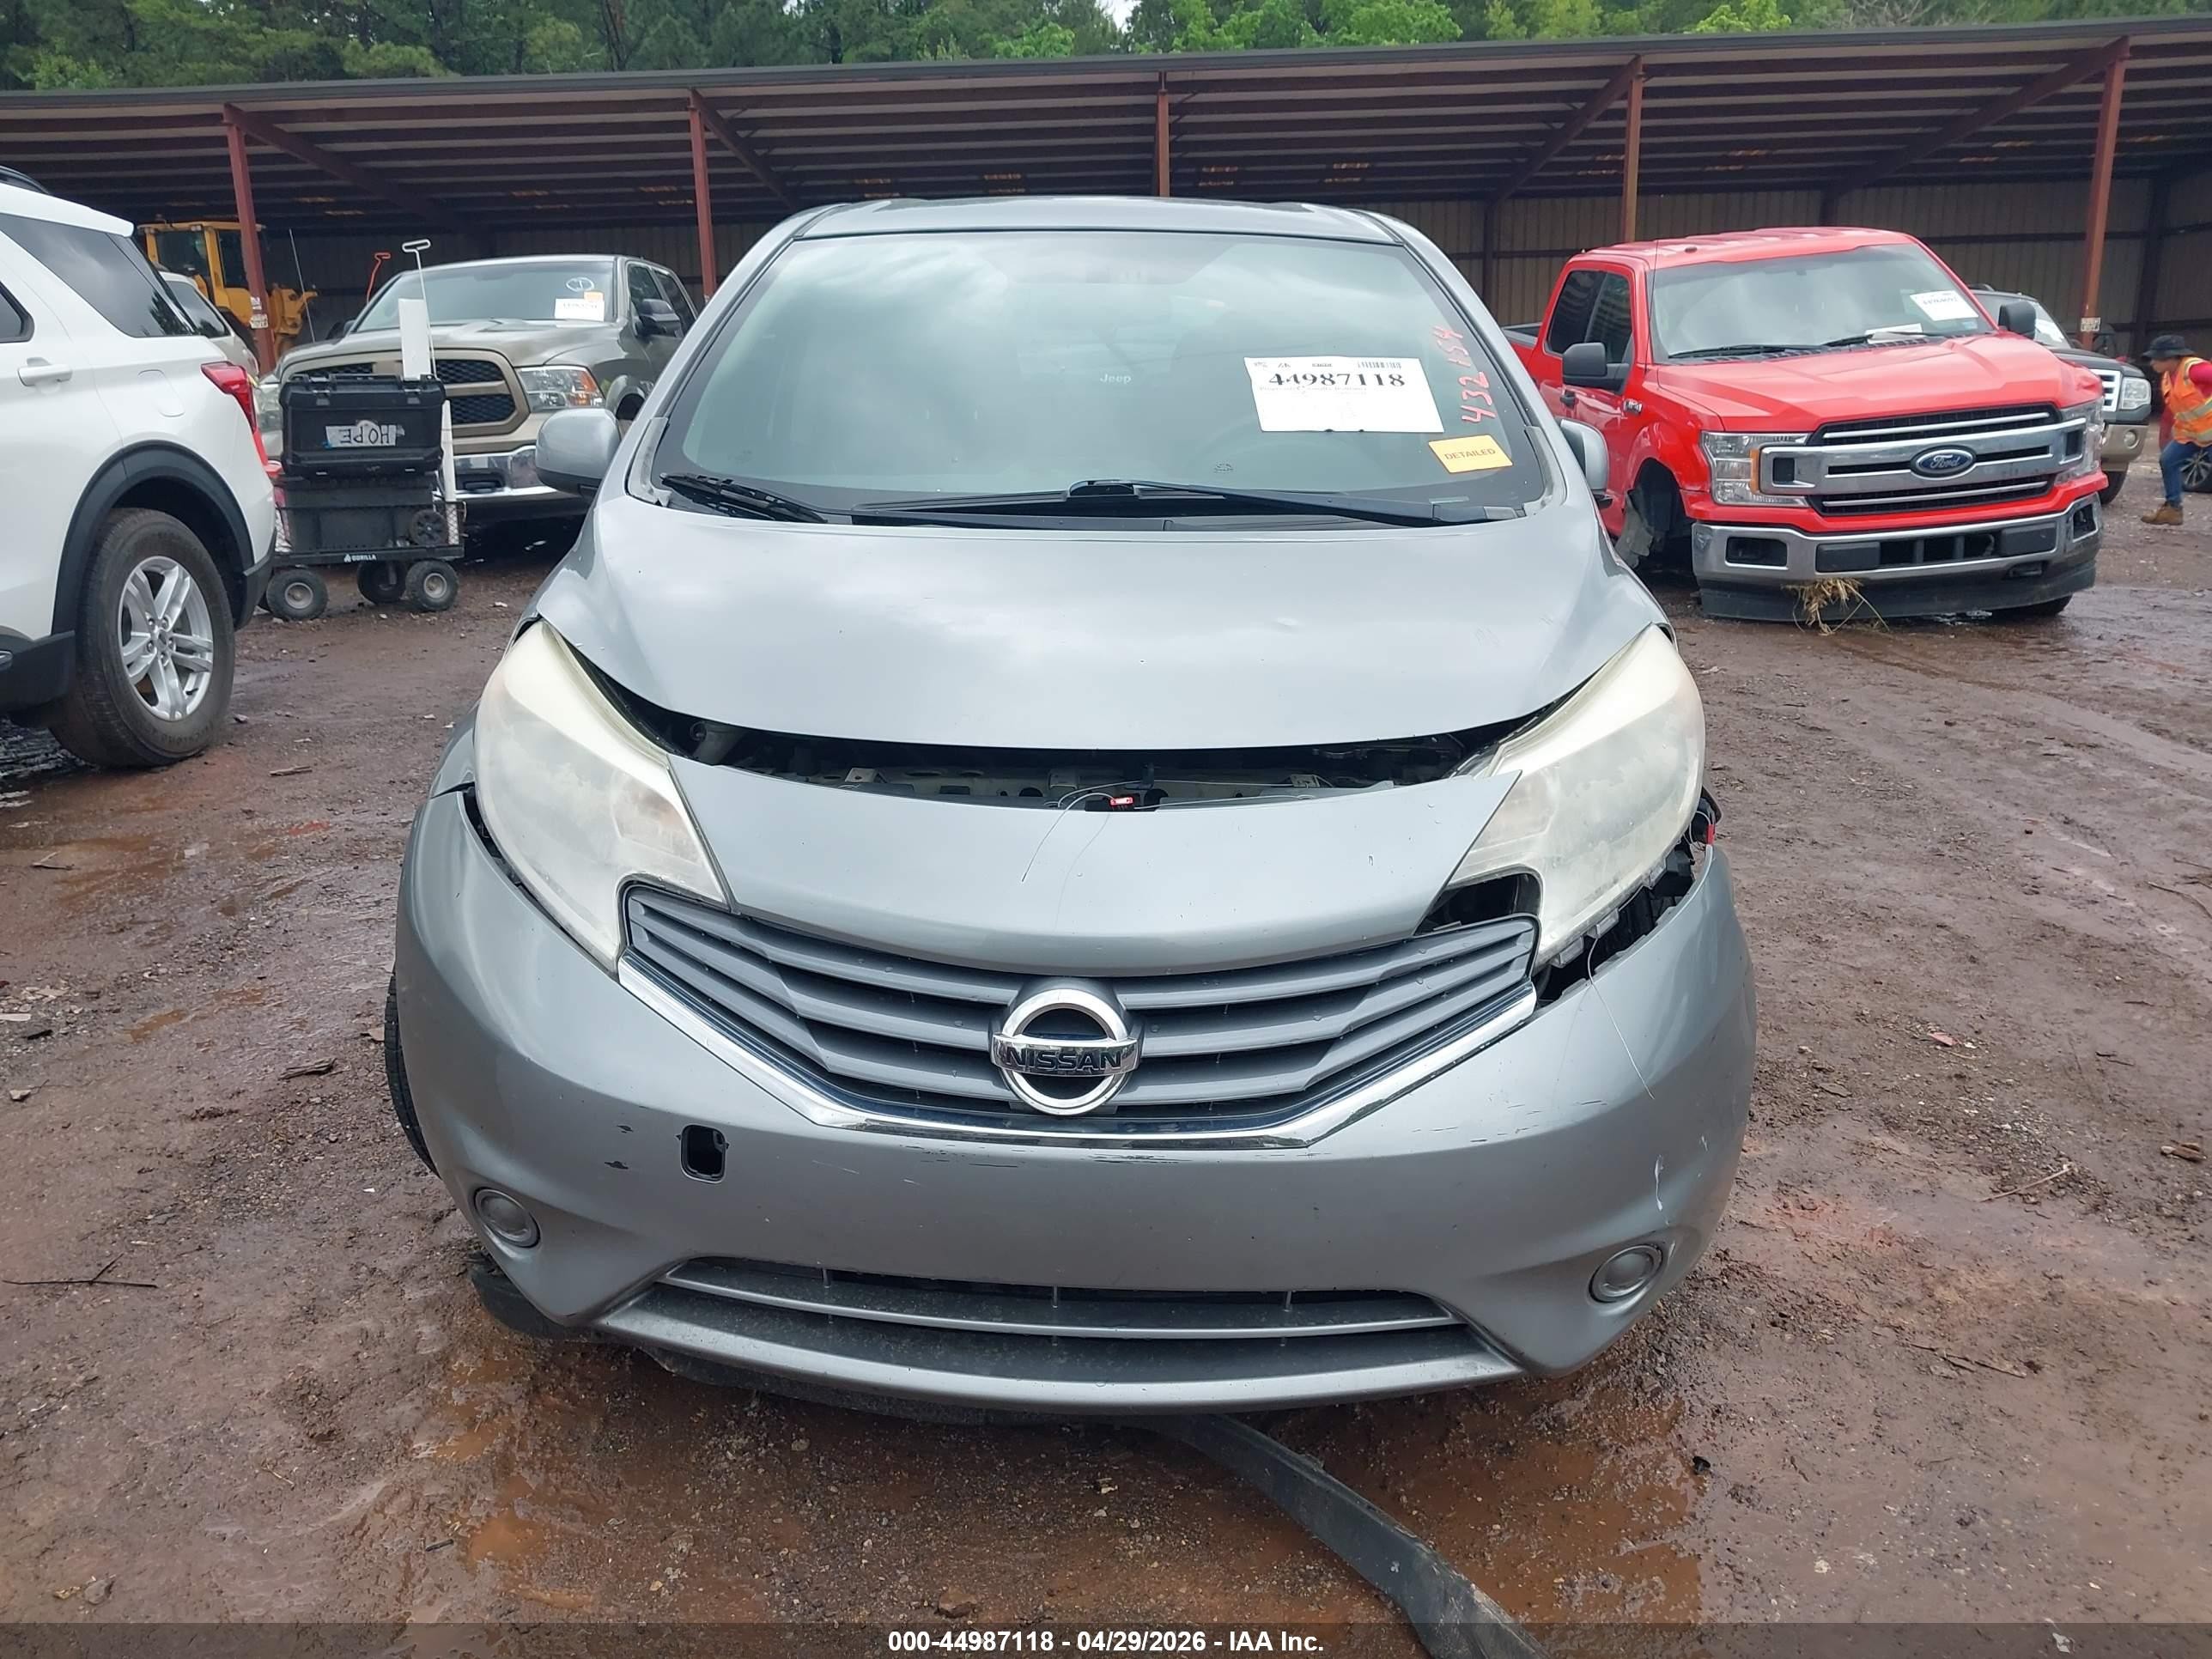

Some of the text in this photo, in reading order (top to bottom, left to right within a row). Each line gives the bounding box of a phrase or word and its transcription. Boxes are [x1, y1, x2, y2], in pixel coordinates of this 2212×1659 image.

[1268, 372, 1407, 387] 44987118
[338, 426, 390, 445] HOPE
[1443, 447, 1497, 461] DETAILED
[1929, 453, 1960, 469] Ford
[1006, 1047, 1122, 1071] NISSAN
